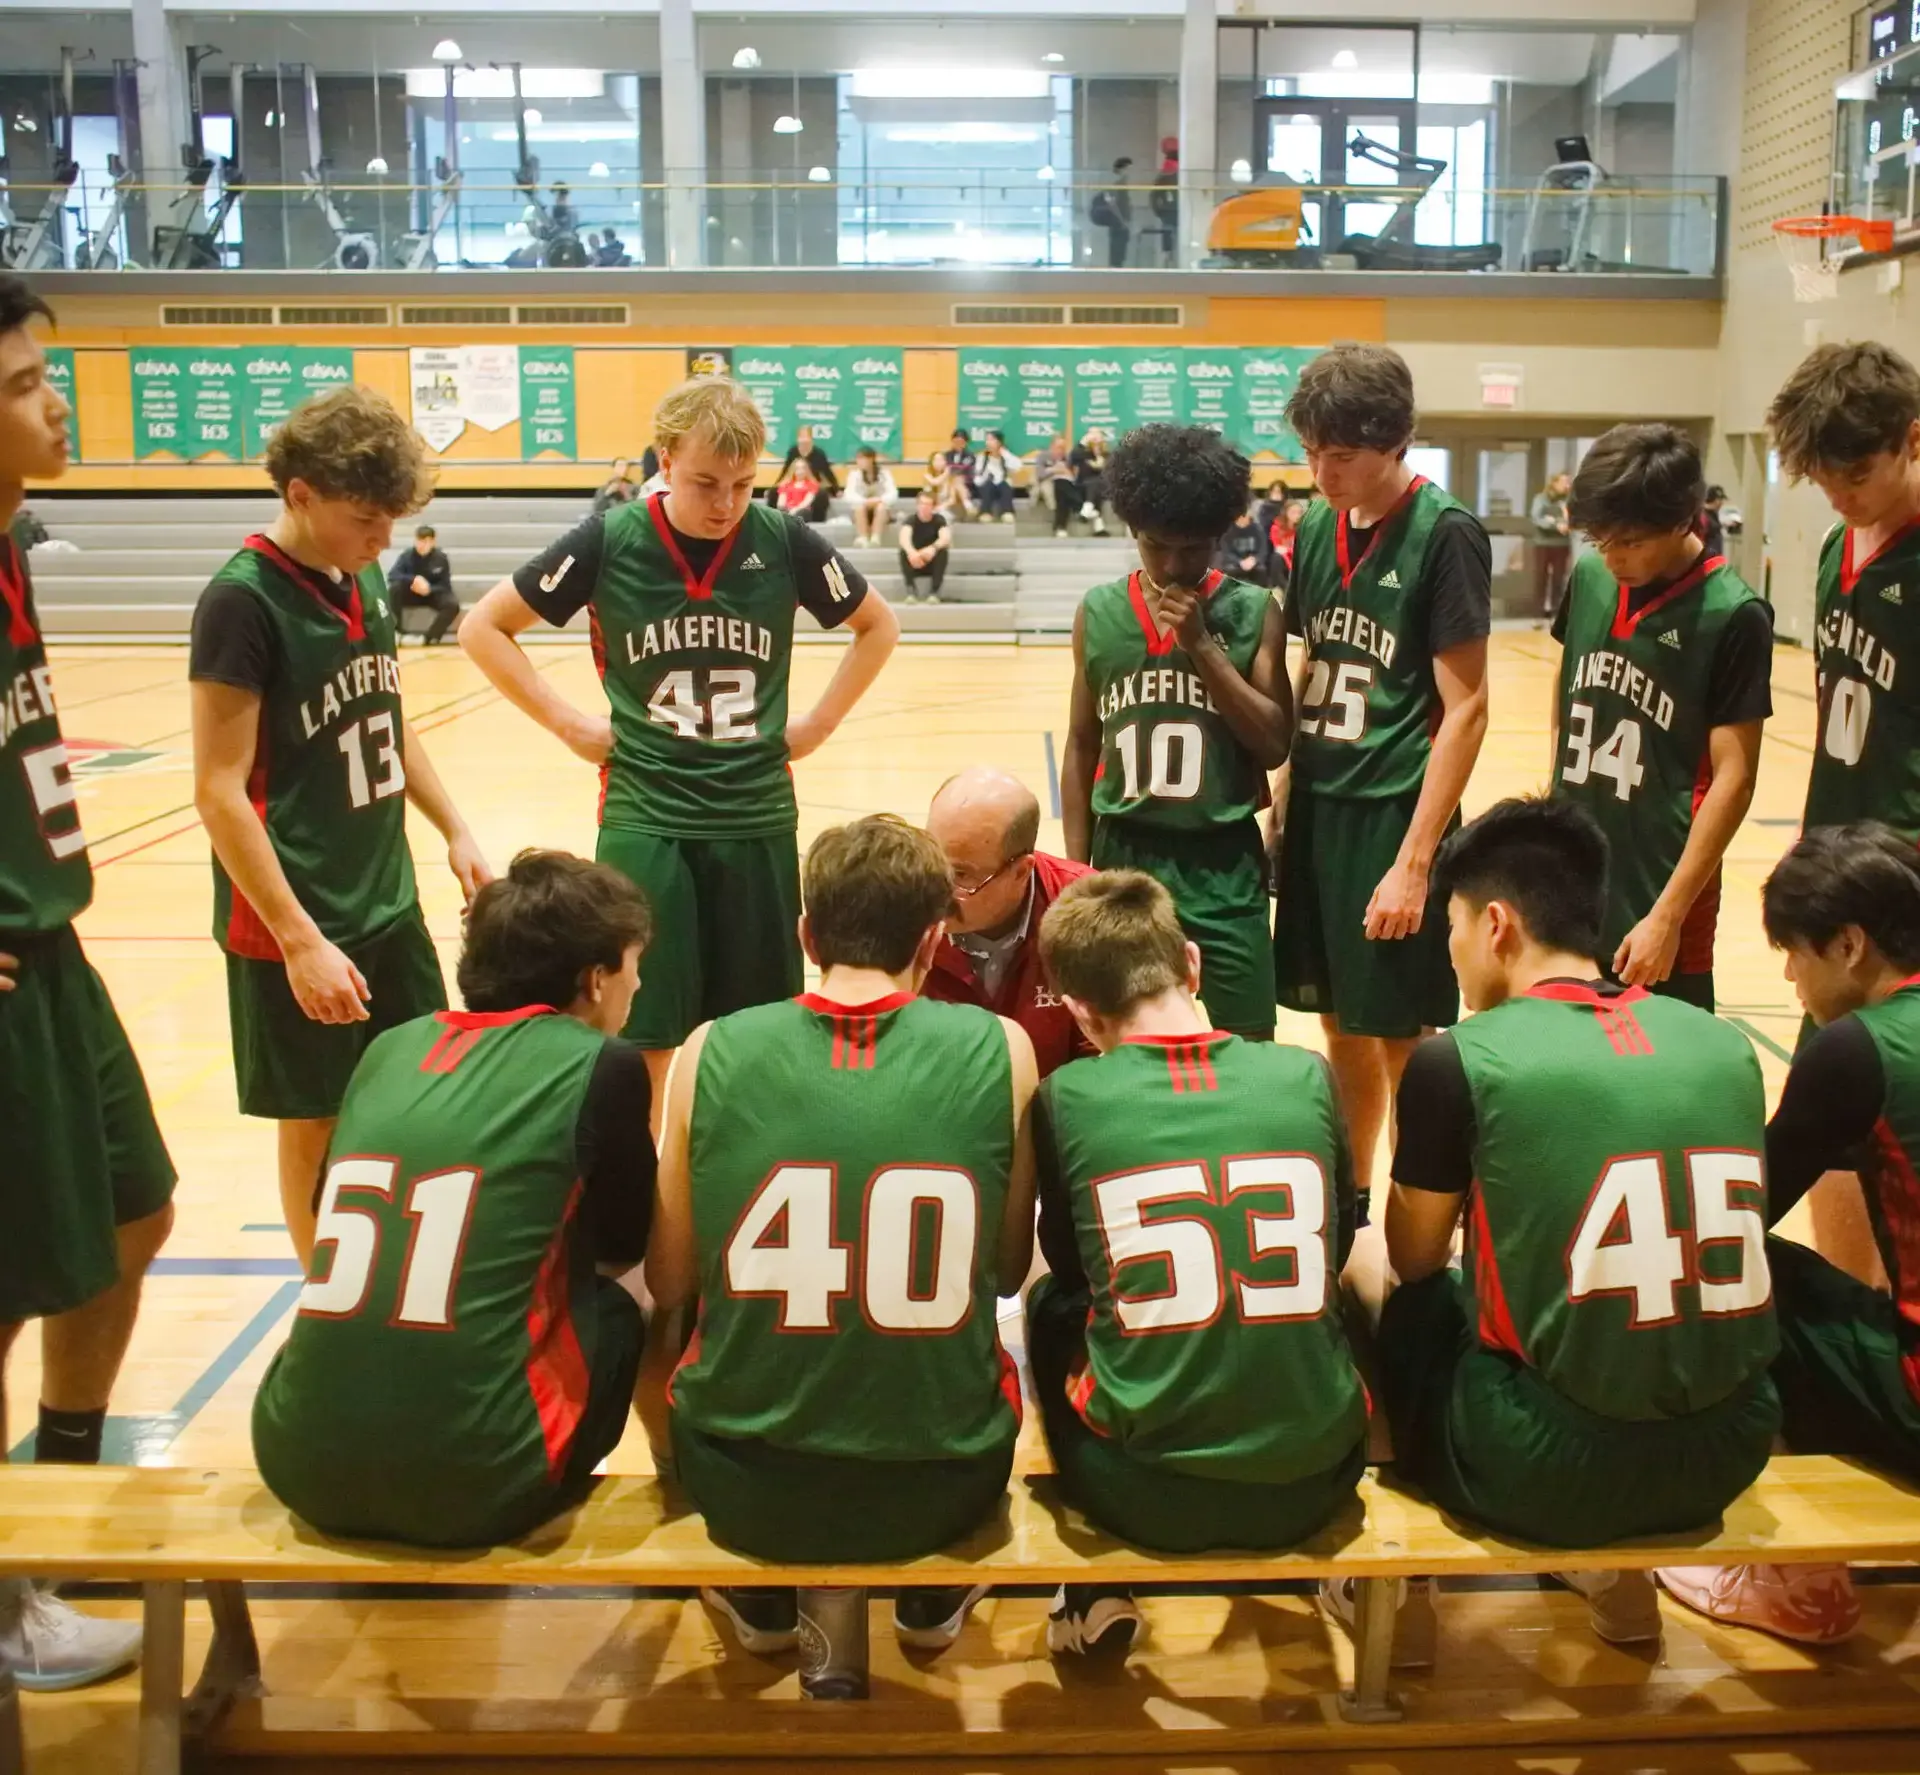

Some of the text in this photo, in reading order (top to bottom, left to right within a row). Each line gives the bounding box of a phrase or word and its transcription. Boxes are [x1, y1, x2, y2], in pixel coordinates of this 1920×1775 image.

[540, 554, 576, 592] J
[822, 556, 851, 602] N
[626, 615, 772, 665] LAKEFIELD
[646, 668, 759, 741] 42
[1300, 659, 1375, 743] 25
[1569, 650, 1675, 732] AKEFIELD
[337, 710, 406, 809] 13
[1115, 721, 1204, 799] 10
[1562, 701, 1645, 802] 34
[299, 1155, 483, 1332] 51
[723, 1161, 981, 1336] 40
[1092, 1151, 1329, 1336] 53
[1567, 1148, 1774, 1330] 45
